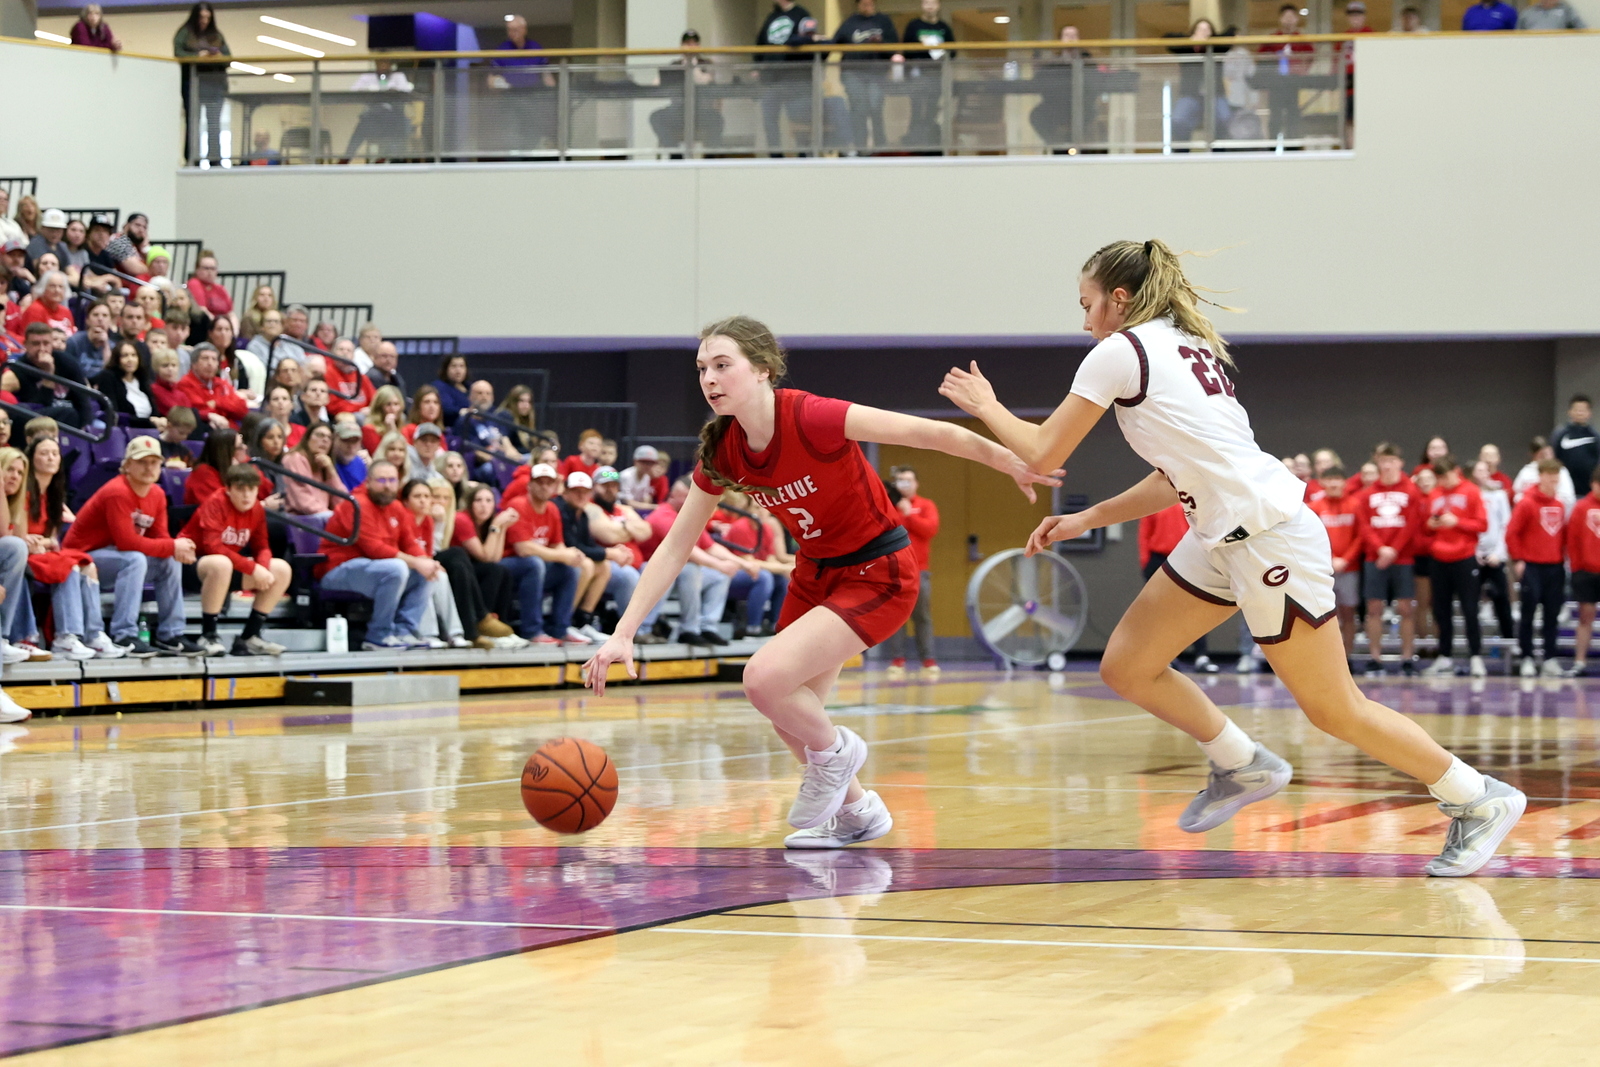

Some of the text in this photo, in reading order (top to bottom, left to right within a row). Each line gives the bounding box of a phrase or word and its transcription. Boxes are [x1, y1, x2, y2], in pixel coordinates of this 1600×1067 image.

[751, 474, 818, 508] ELLEVUE
[786, 507, 822, 540] 2
[1262, 565, 1290, 587] G
